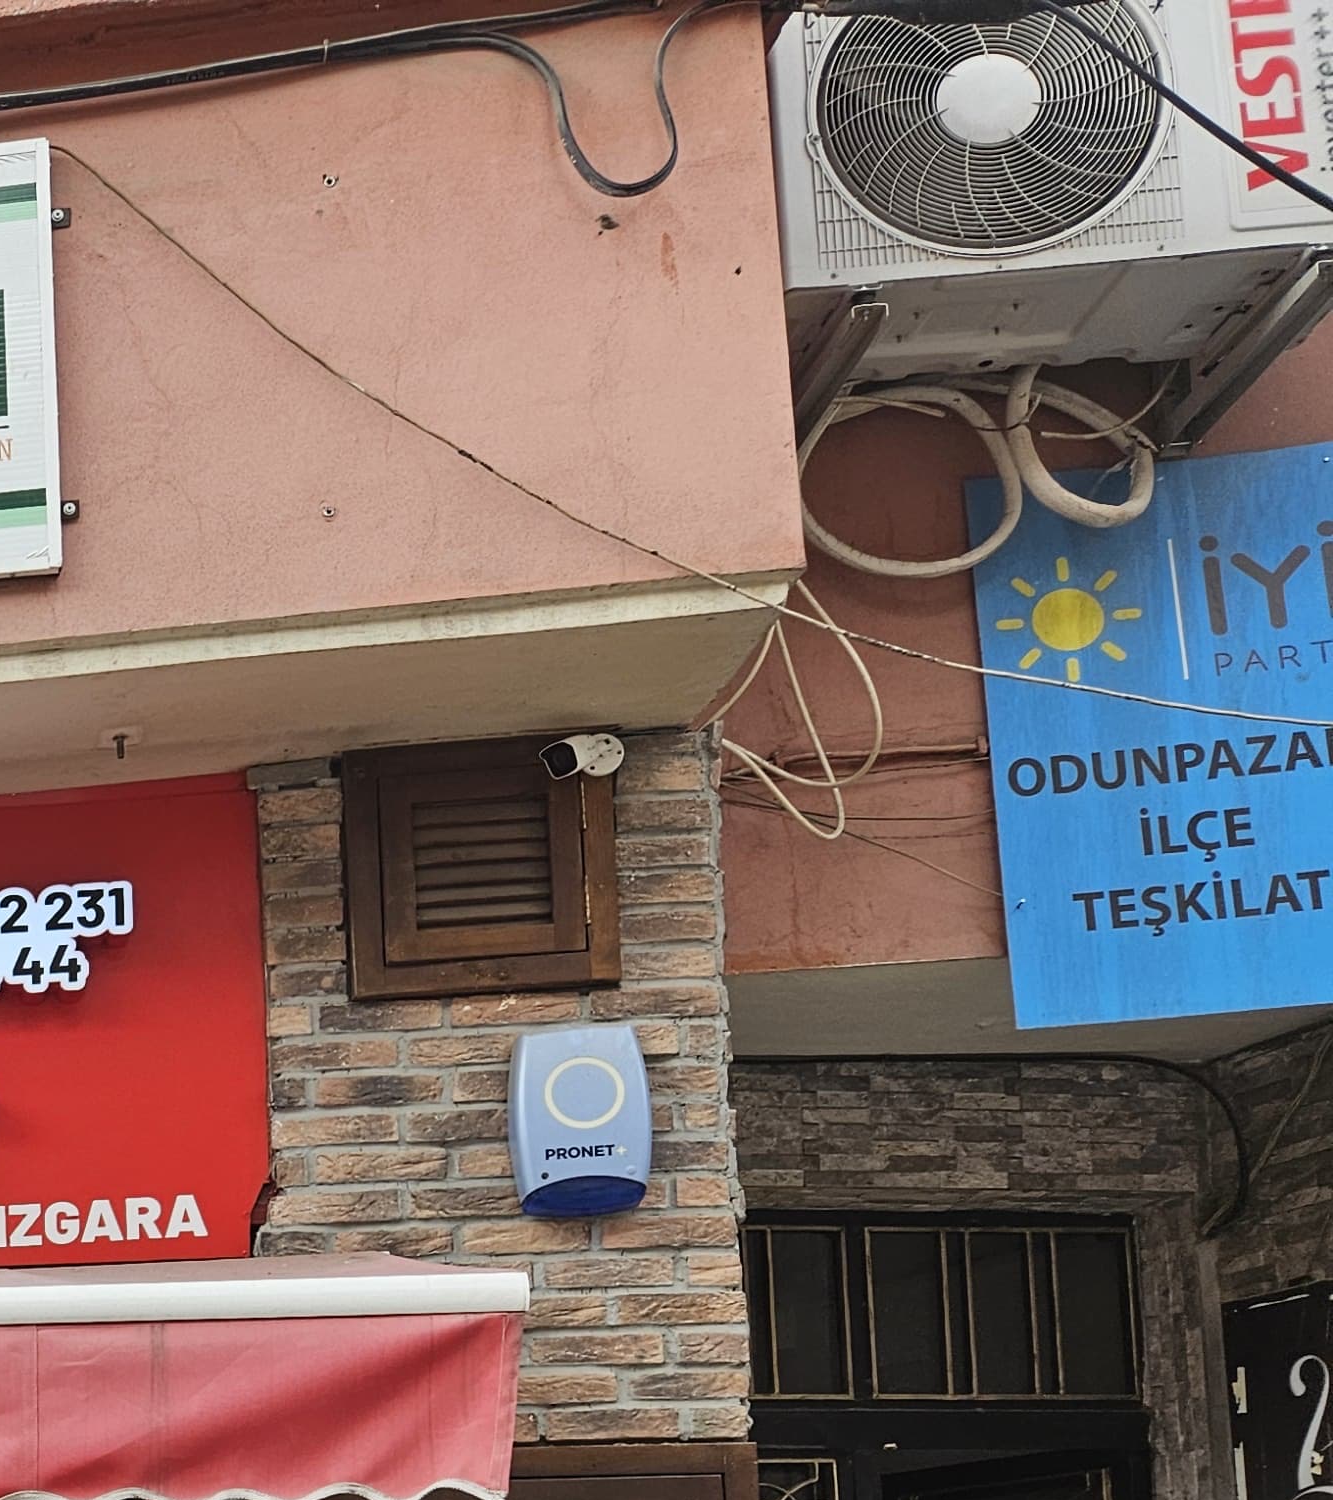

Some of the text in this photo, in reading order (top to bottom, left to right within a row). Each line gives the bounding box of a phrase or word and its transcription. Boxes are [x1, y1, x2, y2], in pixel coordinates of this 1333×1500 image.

[1007, 728, 1333, 797] ODUNPAZA
[1139, 807, 1255, 862] İLÇE
[44, 887, 125, 930] 231
[1072, 869, 1331, 937] TEŞKİLAT
[12, 944, 82, 984] 44
